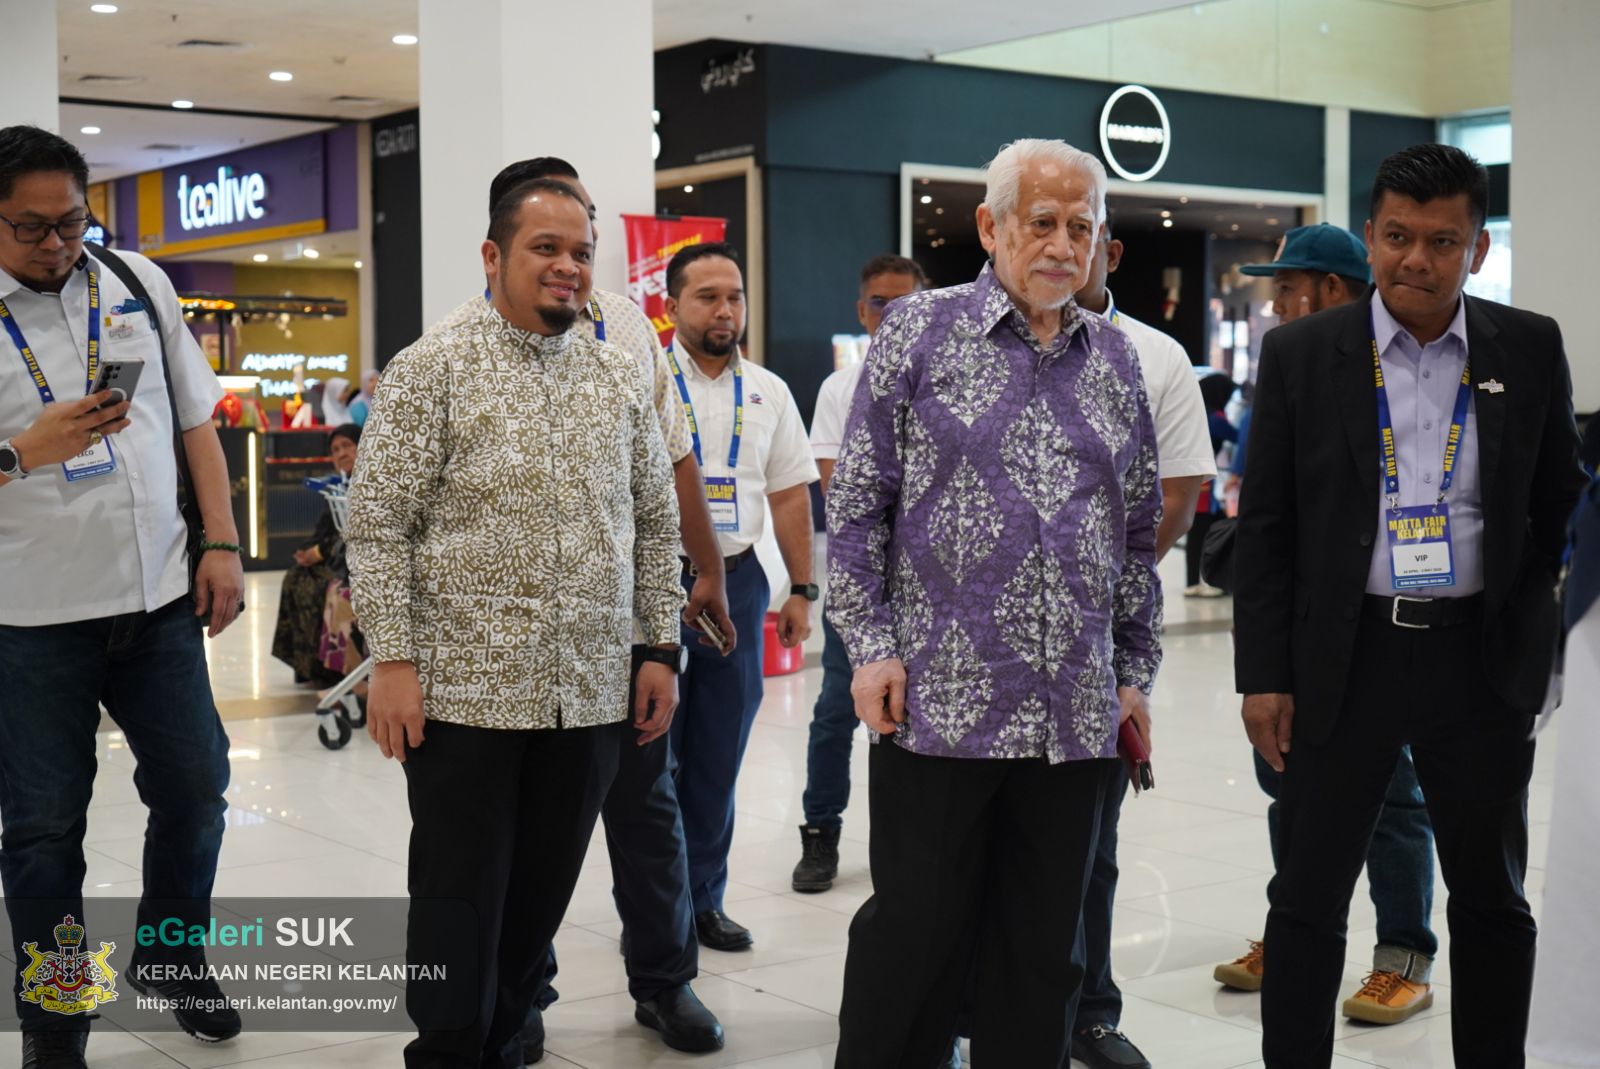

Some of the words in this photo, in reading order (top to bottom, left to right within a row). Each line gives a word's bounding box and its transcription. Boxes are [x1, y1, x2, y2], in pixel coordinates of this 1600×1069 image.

[177, 166, 265, 230] tealive
[89, 287, 98, 308] MATTA
[89, 340, 97, 356] FAIR
[21, 347, 38, 372] MATTA
[33, 371, 46, 388] FAIR
[88, 357, 97, 380] MATTA
[1382, 428, 1394, 458] MATTA
[1449, 424, 1461, 443] FAIR
[1385, 457, 1397, 477] FAIR
[1443, 445, 1457, 472] MATTA
[1389, 518, 1422, 531] MATTA
[1424, 515, 1446, 529] FAIR
[1397, 526, 1444, 540] KELANTAN
[1415, 554, 1428, 562] VIP
